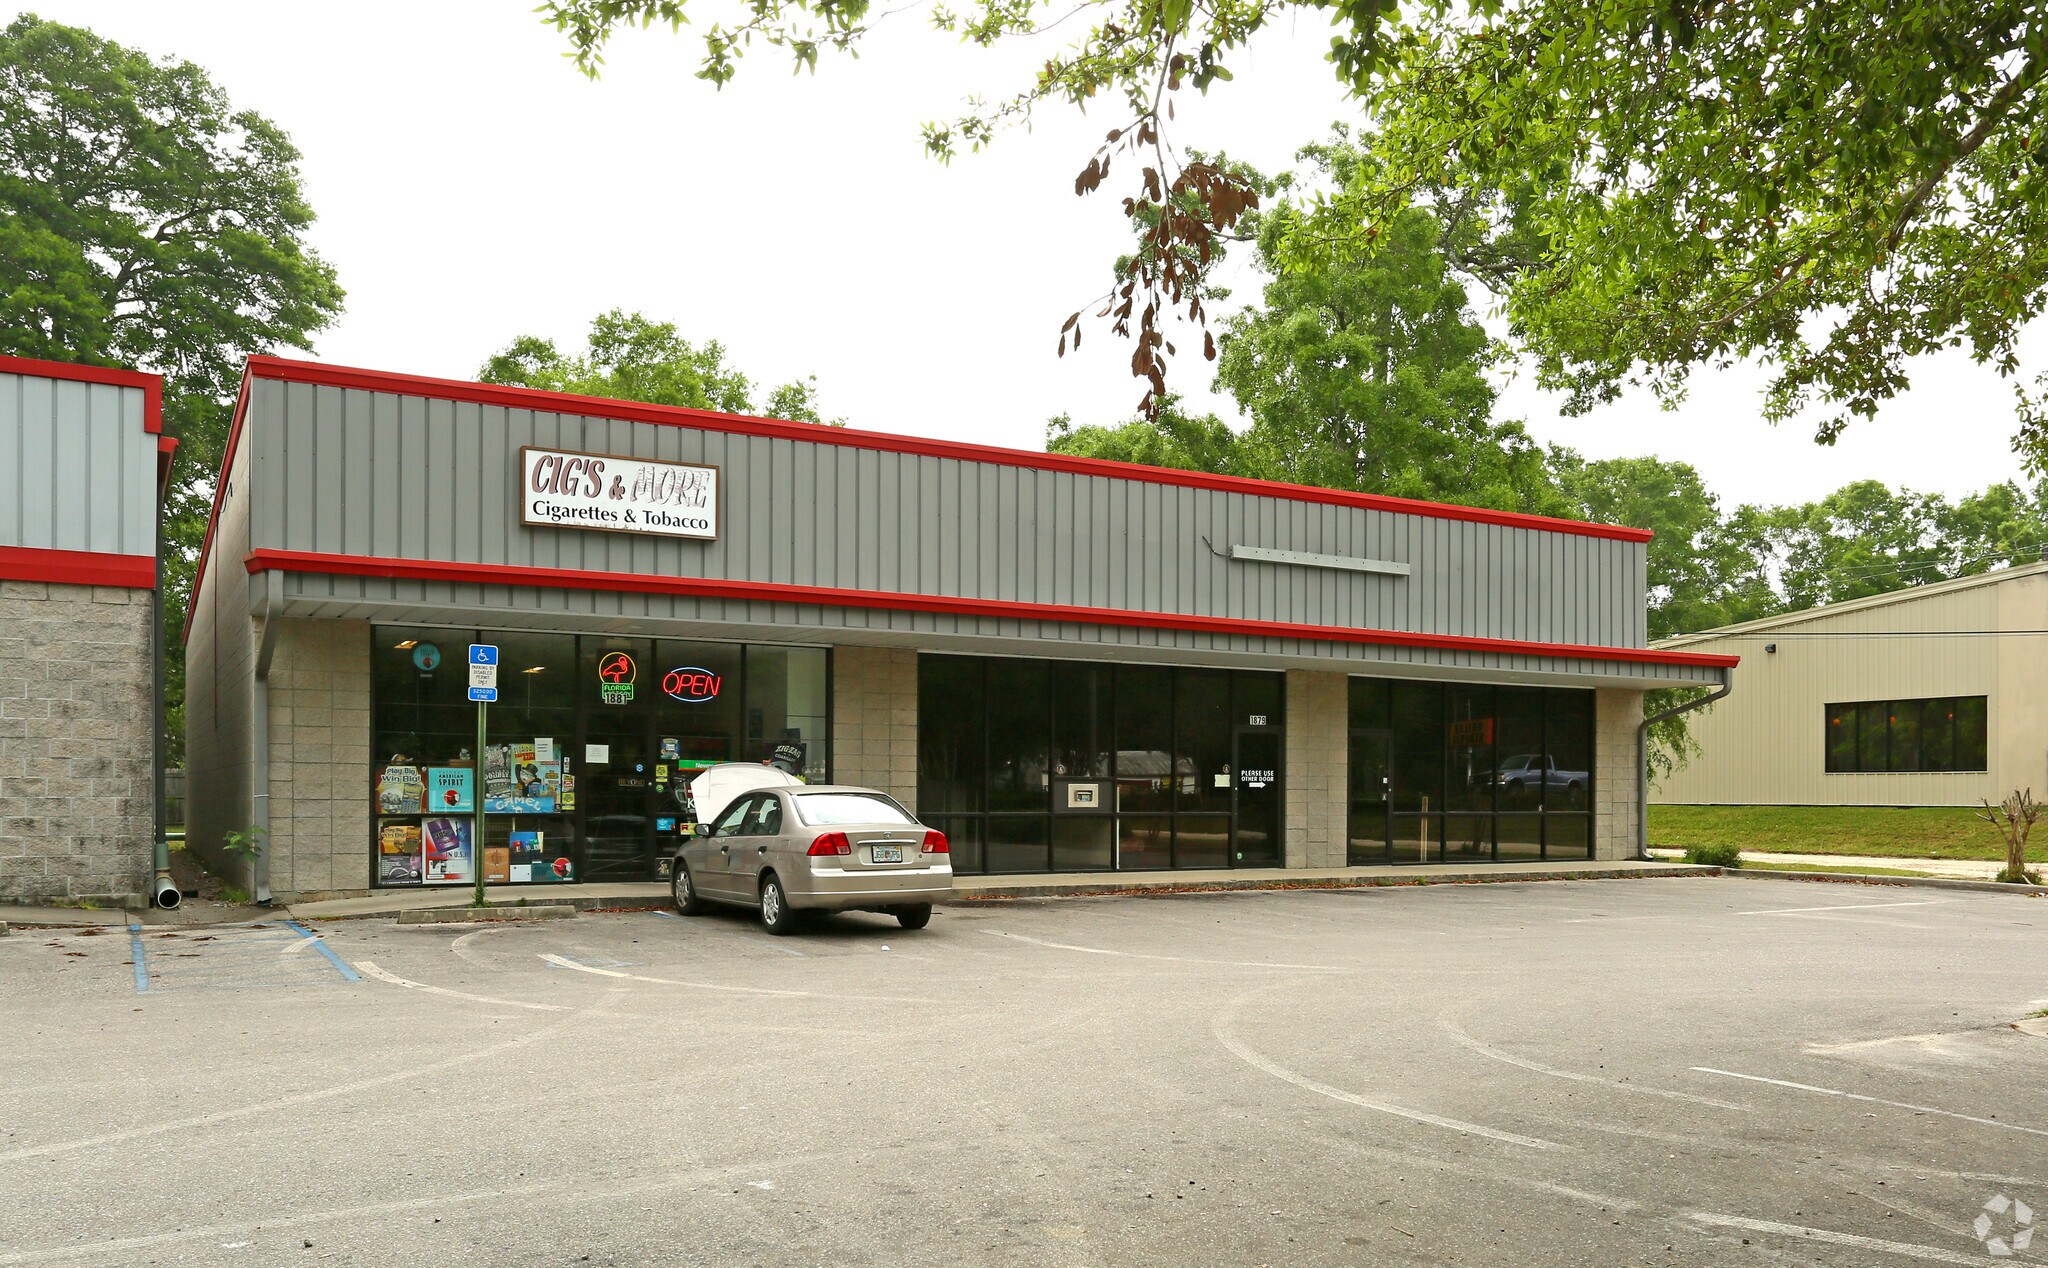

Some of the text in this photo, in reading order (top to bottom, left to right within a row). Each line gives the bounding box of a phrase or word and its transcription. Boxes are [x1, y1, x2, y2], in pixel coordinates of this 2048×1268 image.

[531, 455, 711, 509] CIG'S & MORE
[532, 500, 618, 522] Cigarettes
[624, 508, 637, 524] &
[642, 510, 709, 530] Tobacco
[663, 672, 721, 696] OPEN
[606, 693, 627, 704] 1881
[1250, 715, 1266, 725] 1879
[387, 767, 416, 776] Play Big
[495, 797, 541, 810] CAMEL
